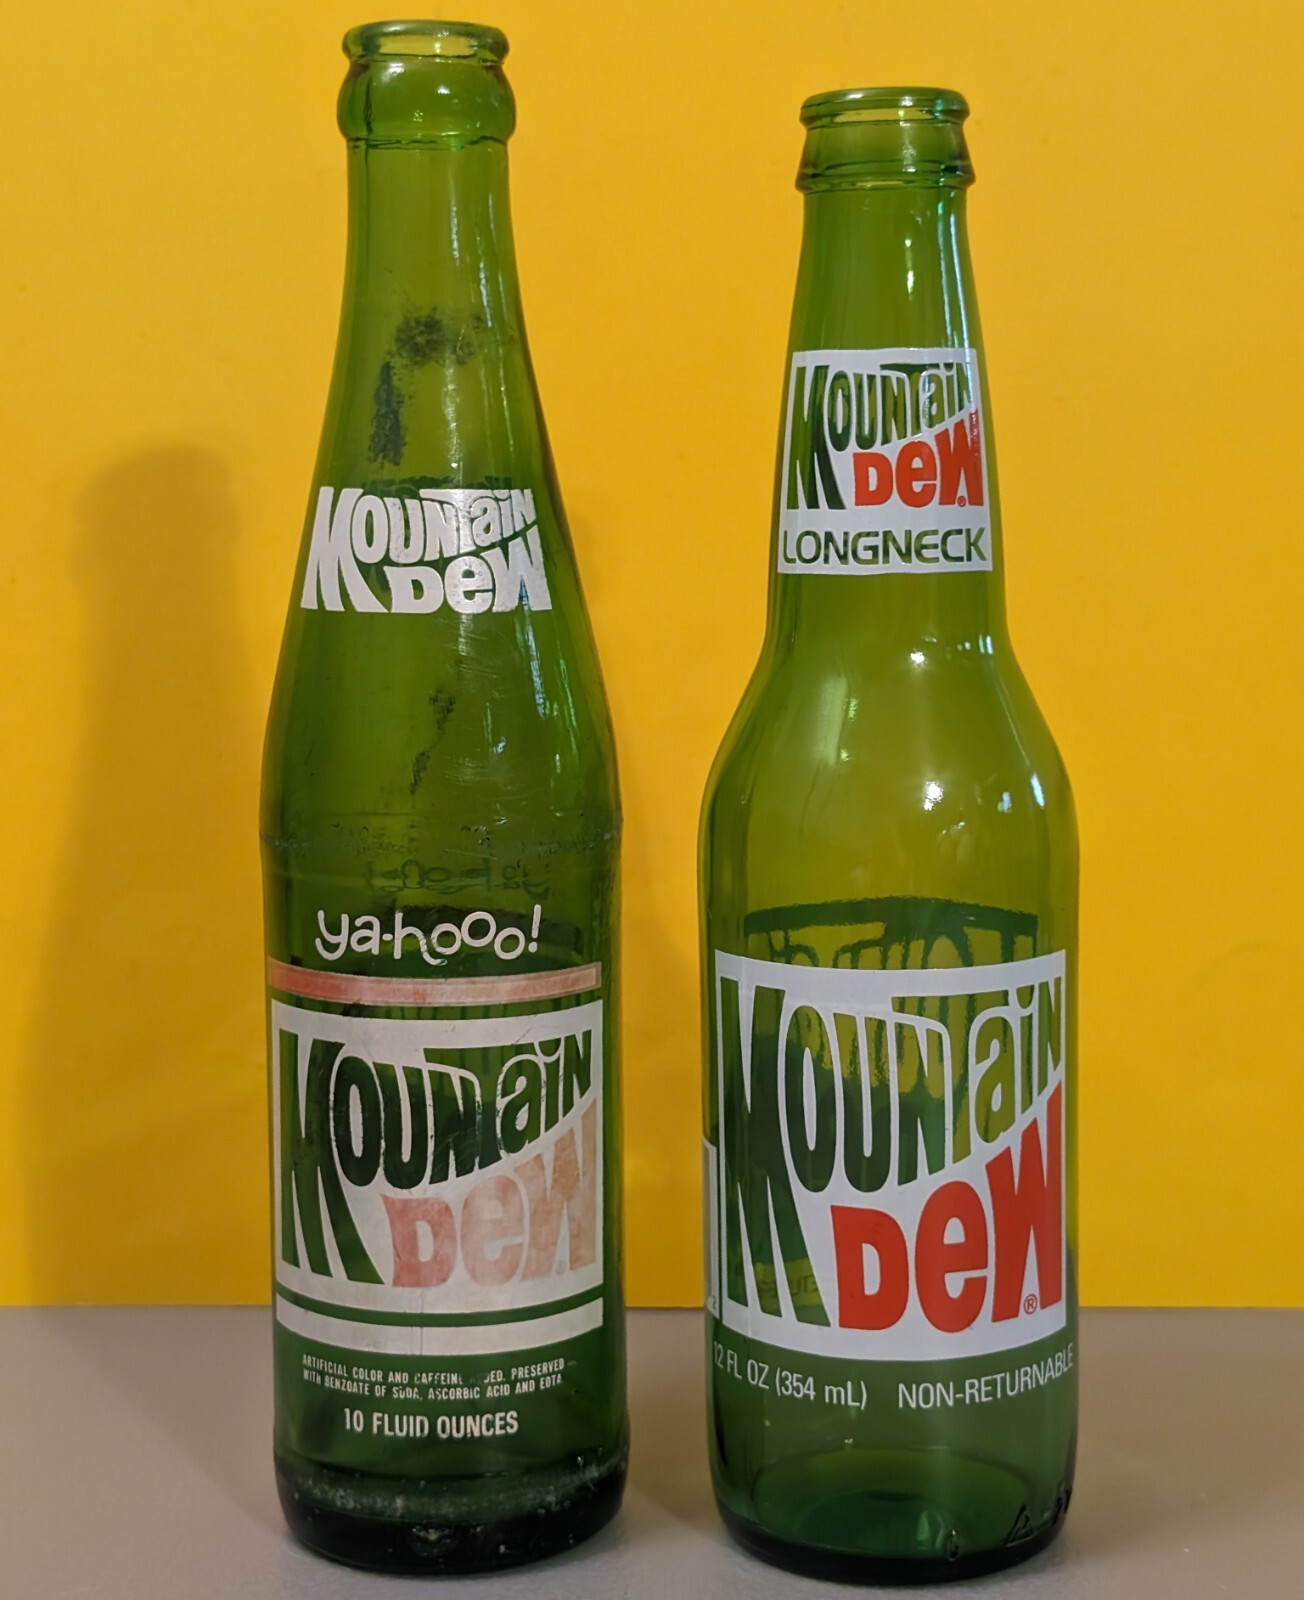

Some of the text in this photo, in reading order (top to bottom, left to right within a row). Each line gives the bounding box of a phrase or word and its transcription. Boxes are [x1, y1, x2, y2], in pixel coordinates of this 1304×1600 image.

[783, 527, 987, 565] LONGNECK
[302, 1353, 348, 1377] ARTIFICIAL
[352, 1366, 384, 1382] COLOR
[388, 1371, 409, 1384] AND
[511, 1357, 565, 1380] PRESERVED
[303, 1367, 322, 1385] WITH
[324, 1375, 370, 1395] BENZOATE
[374, 1384, 387, 1397] OF
[427, 1387, 480, 1400] ASCORBIC
[486, 1384, 511, 1398] ACID
[515, 1380, 536, 1394] AND
[713, 1341, 867, 1410] 12 FL OZ (354 mL)
[898, 1342, 1074, 1409] NON-RETURNABLE
[343, 1407, 519, 1439] 10 FLUID OUNCES
